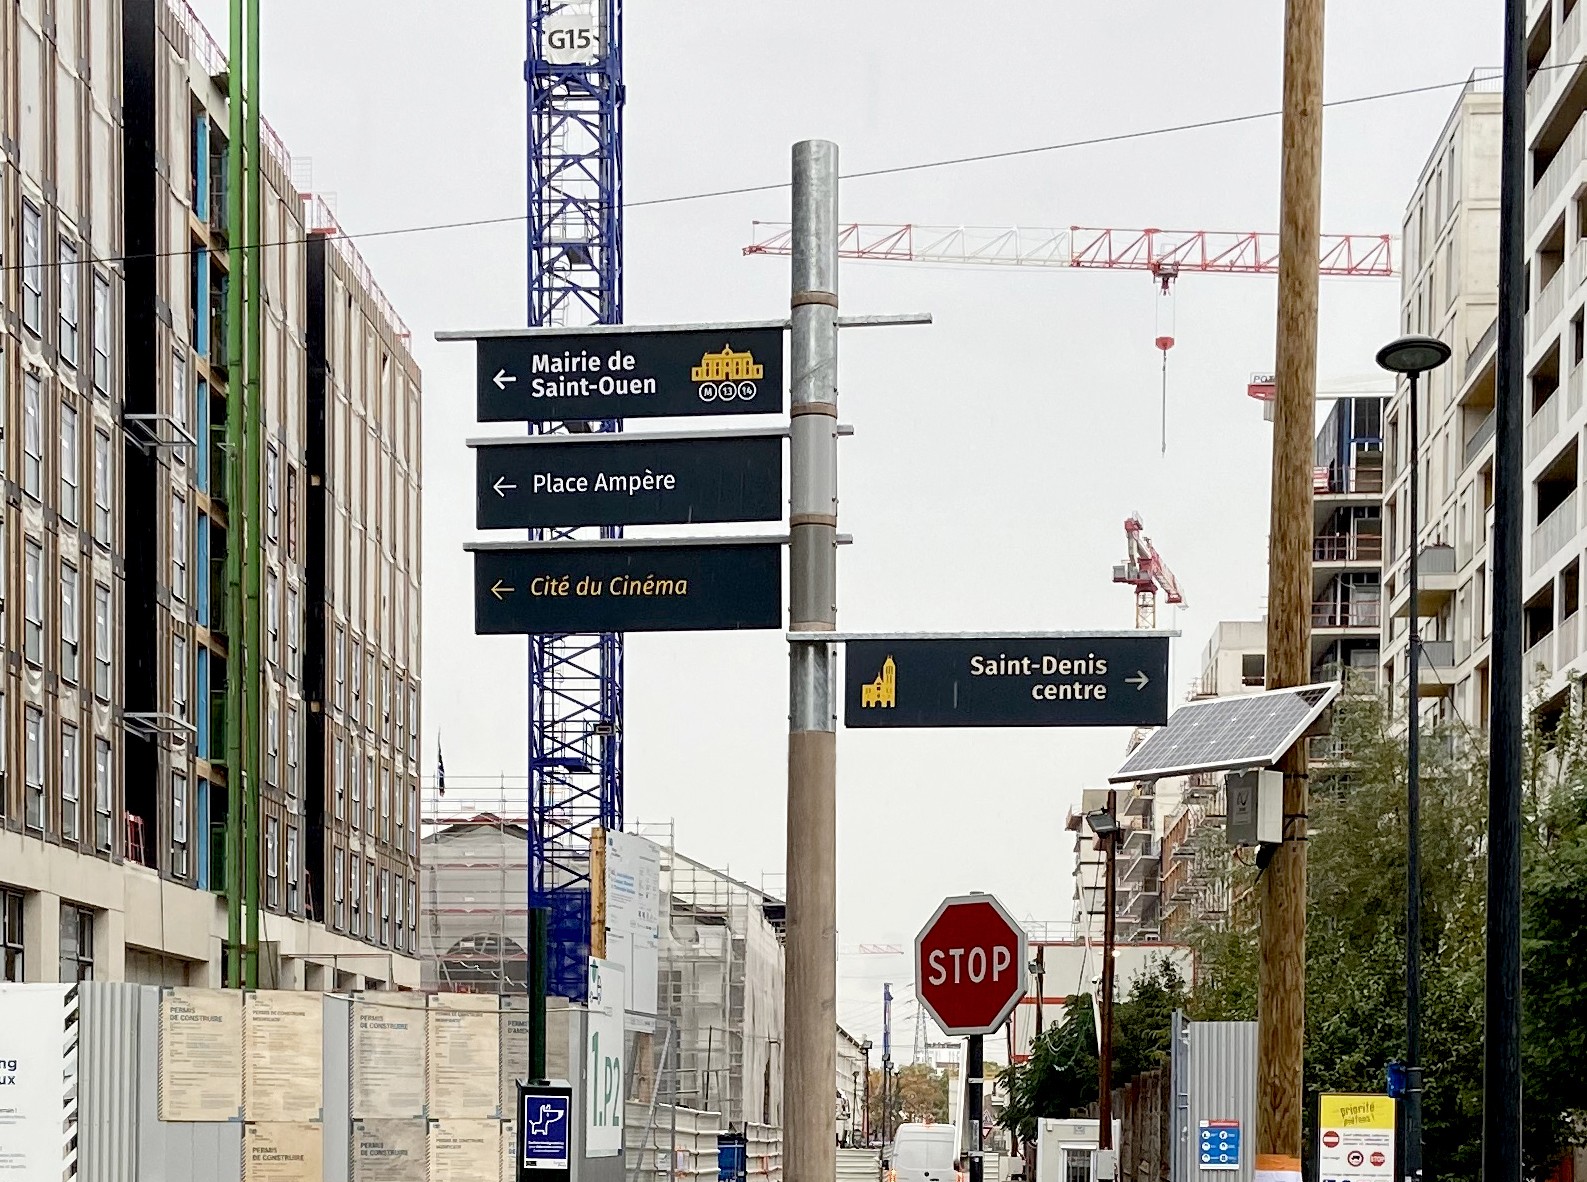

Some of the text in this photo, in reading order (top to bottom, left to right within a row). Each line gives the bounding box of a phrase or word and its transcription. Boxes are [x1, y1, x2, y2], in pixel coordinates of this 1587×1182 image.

[548, 29, 591, 49] G15
[531, 350, 636, 373] Mairie de
[531, 376, 657, 398] Saint-Ouen
[532, 469, 676, 495] Place Ampère
[530, 574, 688, 596] Cité du Cinéma
[970, 652, 1108, 676] Saint-Denis
[1031, 683, 1107, 701] centre
[928, 945, 1011, 985] STOP
